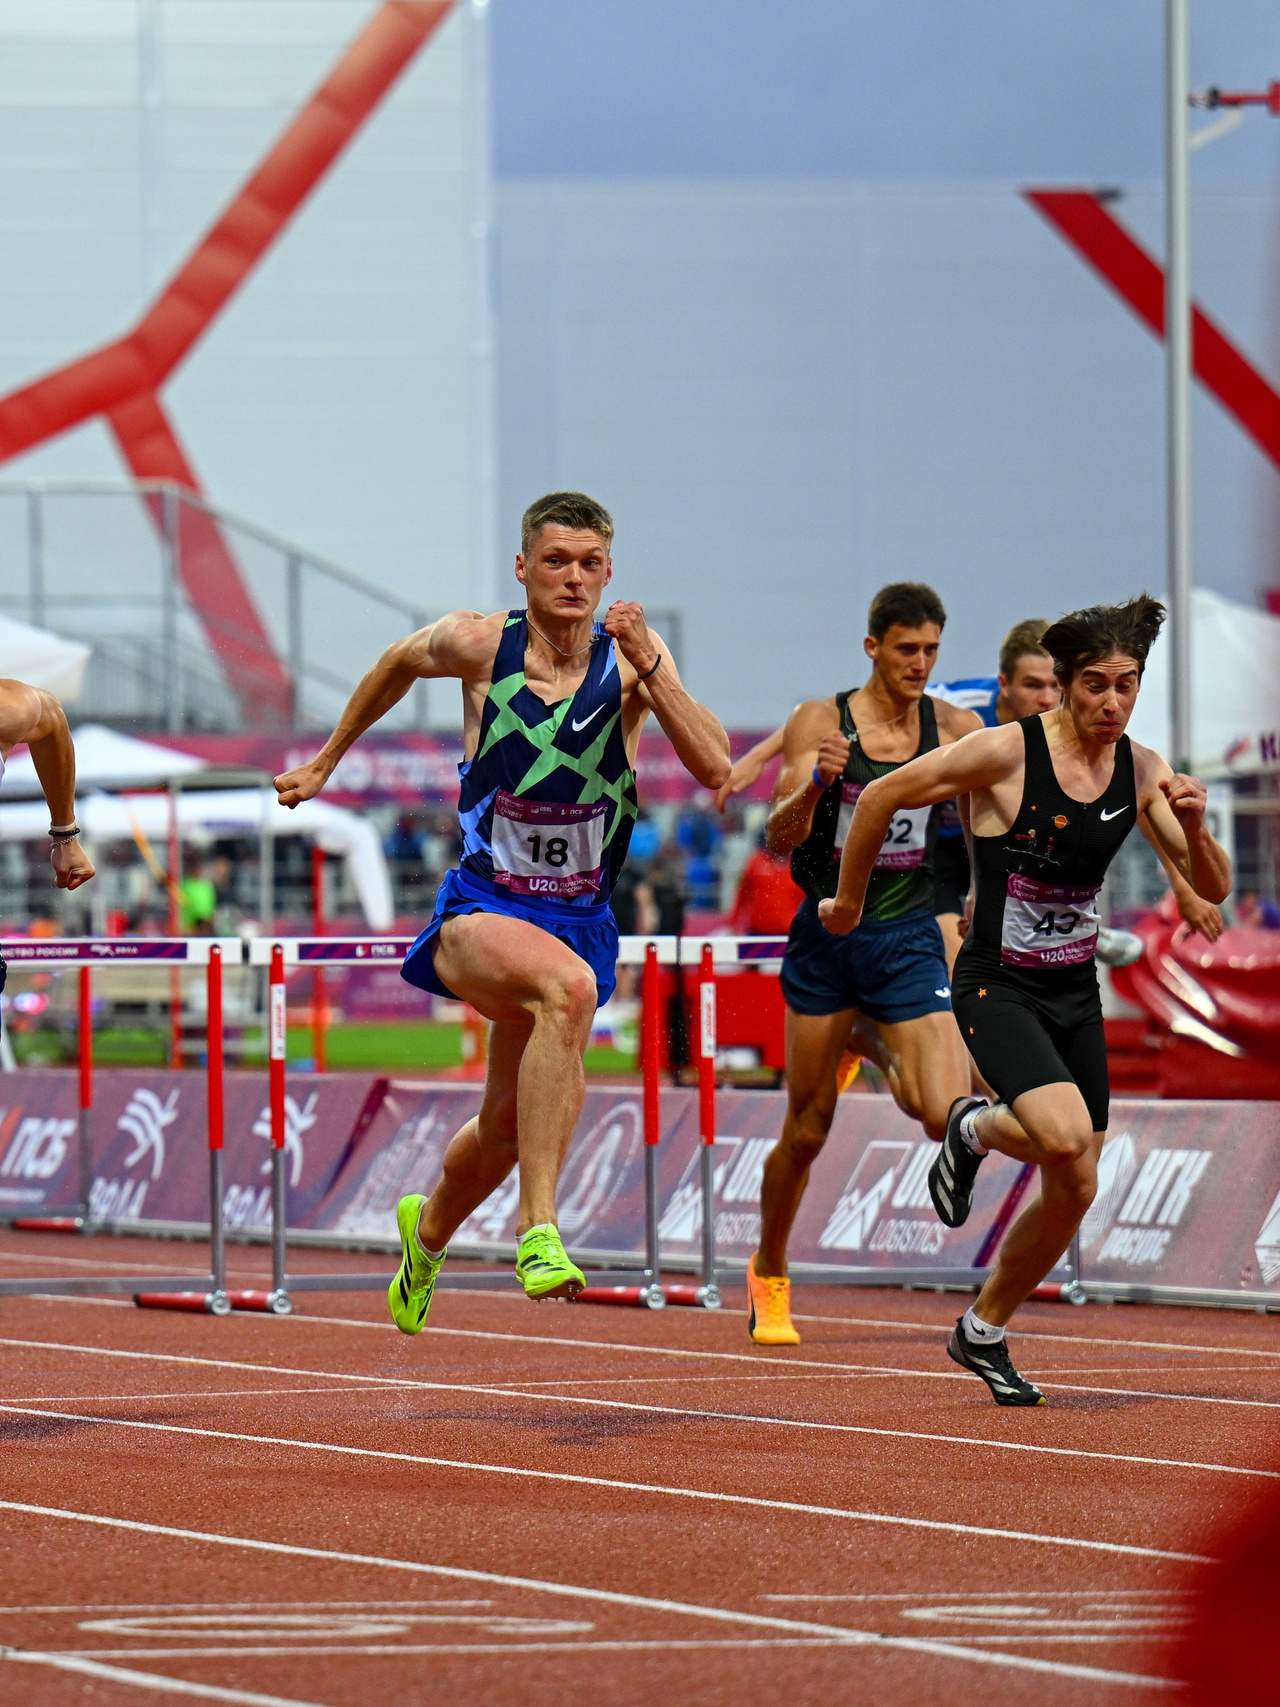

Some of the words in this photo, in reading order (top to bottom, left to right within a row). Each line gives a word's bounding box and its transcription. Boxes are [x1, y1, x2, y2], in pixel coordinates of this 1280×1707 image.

[527, 835, 569, 868] 18
[529, 878, 559, 892] U20
[1032, 911, 1081, 937] 43
[35, 946, 79, 957] РОССИИ
[371, 944, 397, 956] ПСБ
[1040, 949, 1066, 963] U20
[0, 1116, 78, 1180] ПСБ
[1117, 1149, 1213, 1226] НГК
[868, 1218, 946, 1256] LOGISTICS
[1096, 1226, 1172, 1264] ресурс
